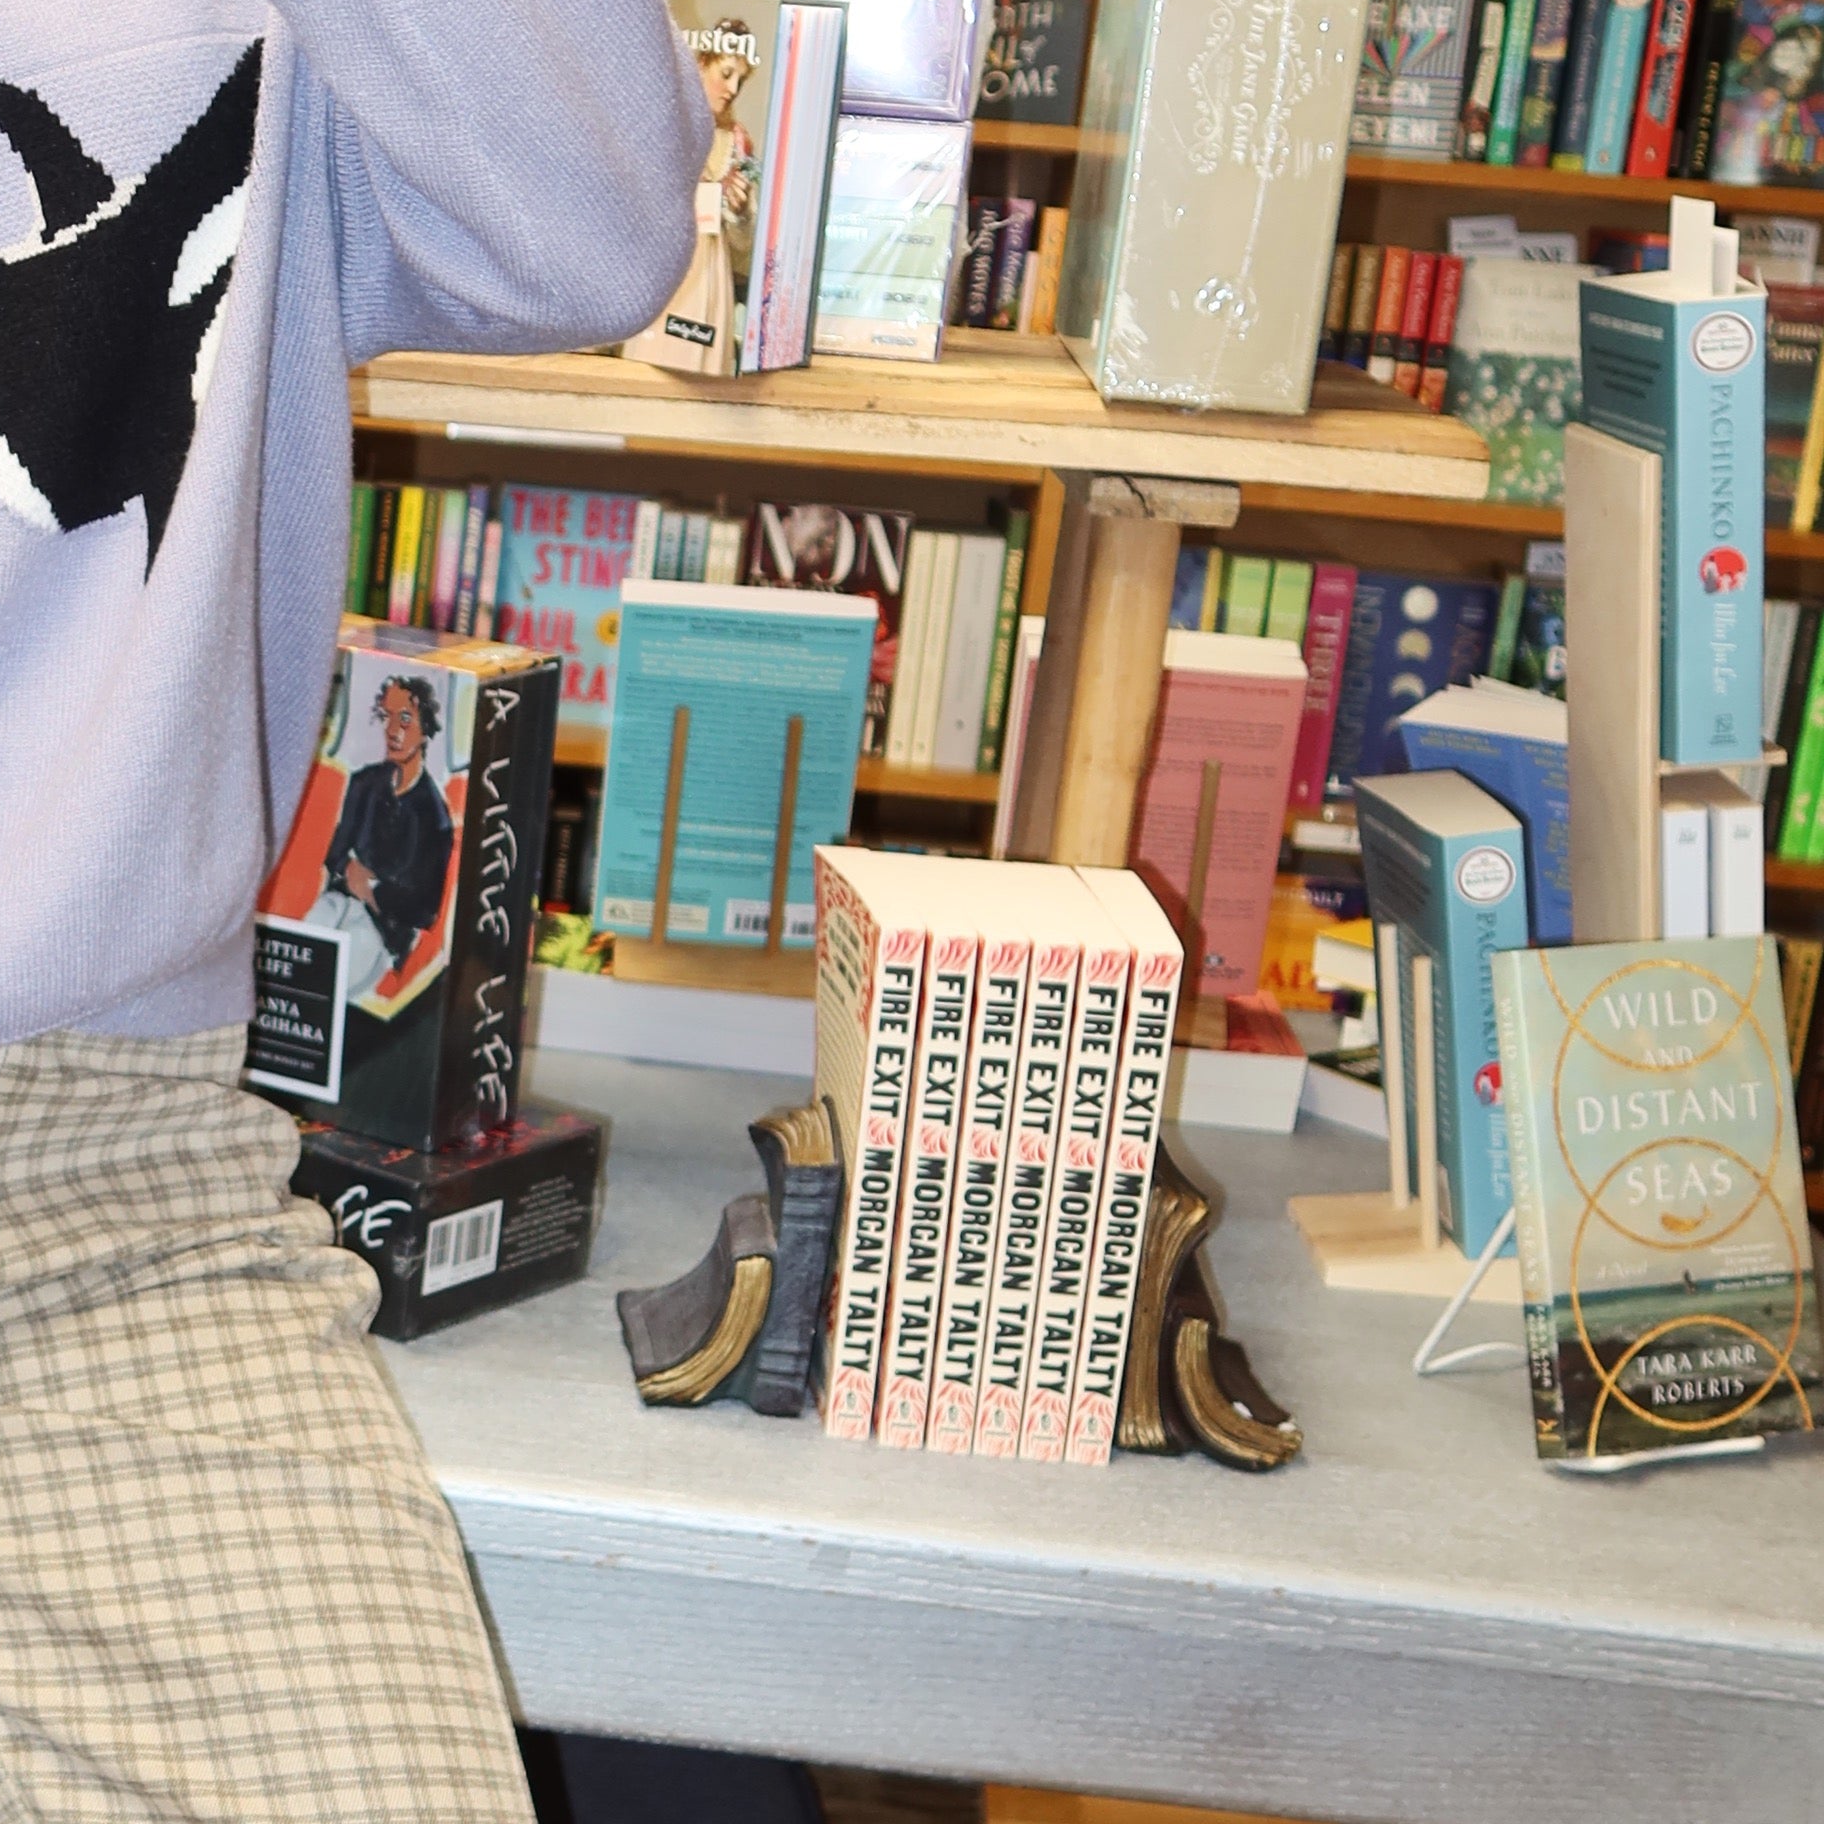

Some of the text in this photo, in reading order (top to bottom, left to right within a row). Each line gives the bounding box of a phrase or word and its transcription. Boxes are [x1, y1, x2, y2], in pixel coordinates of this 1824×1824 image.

[510, 490, 571, 538] THE
[1710, 383, 1735, 540] PACHINKO
[499, 602, 579, 654] PAUL
[473, 686, 520, 1122] A LITTLE LIFE
[869, 964, 915, 1120] FIRE EXIT
[921, 973, 967, 1127] FIRE EXIT
[973, 978, 1019, 1132] FIRE EXIT
[1022, 981, 1067, 1136] FIRE EXIT
[1070, 985, 1118, 1140] FIRE EXIT
[1121, 989, 1172, 1144] FIRE EXIT
[1604, 987, 1717, 1030] WILD
[1643, 1045, 1694, 1067] AND
[1577, 1081, 1762, 1136] DISTANT
[1626, 1157, 1733, 1205] SEAS
[841, 1147, 893, 1374] MORGAN TALTY
[894, 1156, 948, 1384] MORGAN TALTY
[943, 1160, 998, 1389] MORGAN TALTY
[1510, 1112, 1532, 1214] DISTANT
[1523, 1226, 1540, 1283] SEAS
[990, 1164, 1046, 1392] MORGAN TALTY
[1037, 1169, 1095, 1396] MORGAN TALTY
[1085, 1172, 1145, 1399] MORGAN TALTY
[1637, 1344, 1757, 1376] TARA KARR
[1651, 1378, 1745, 1407] ROBERTS
